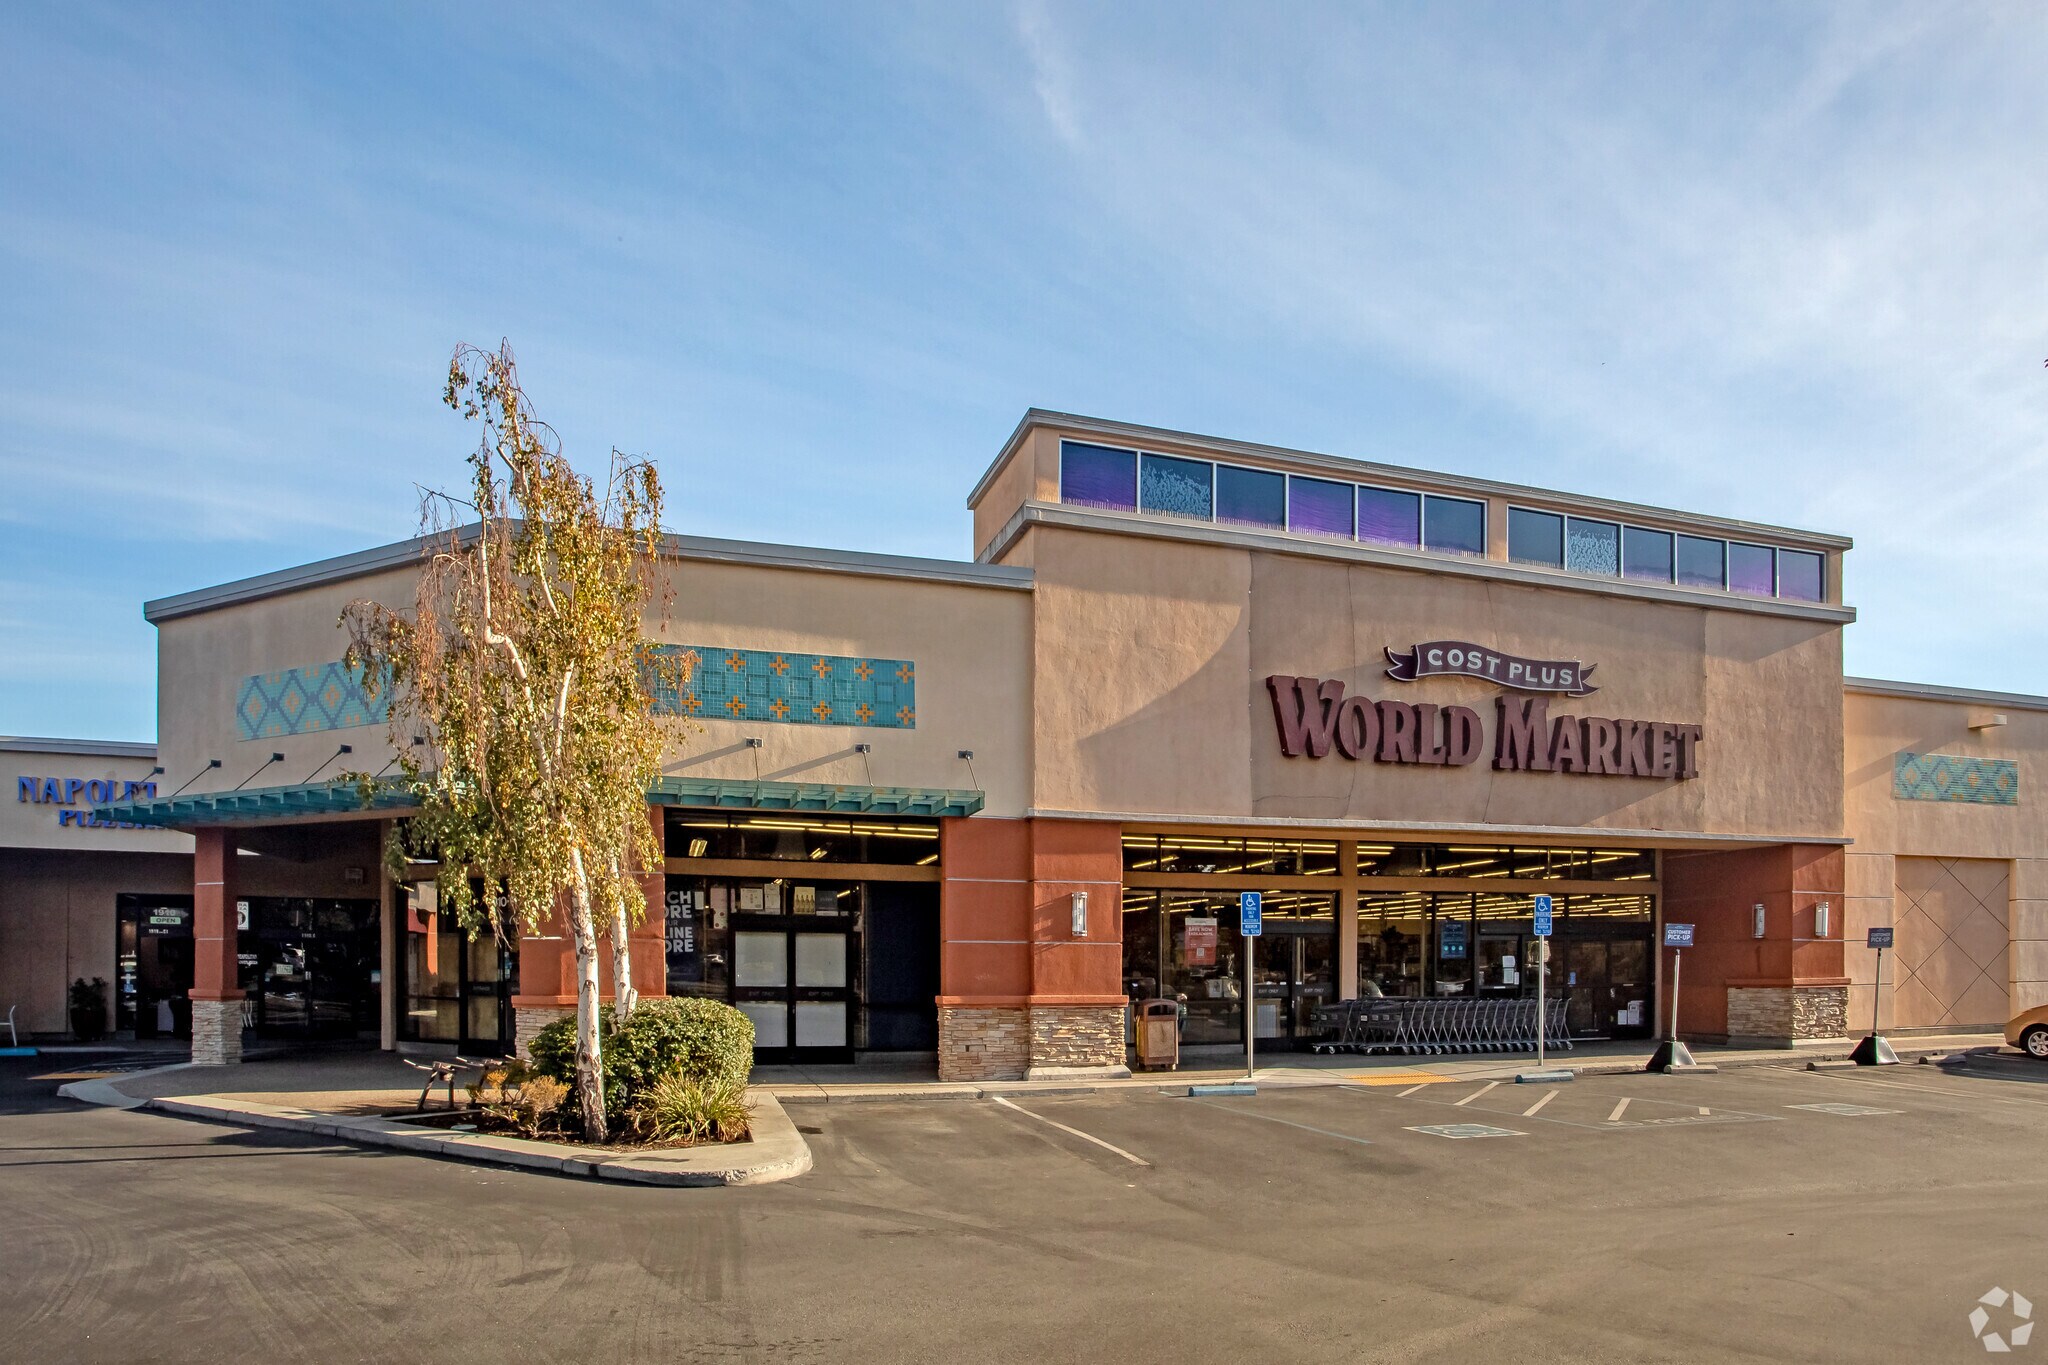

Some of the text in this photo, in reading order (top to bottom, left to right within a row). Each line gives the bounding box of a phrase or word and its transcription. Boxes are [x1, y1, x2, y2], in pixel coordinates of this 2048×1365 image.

[1427, 649, 1573, 685] COST PLUS
[1266, 675, 1703, 779] WORLD MARKET
